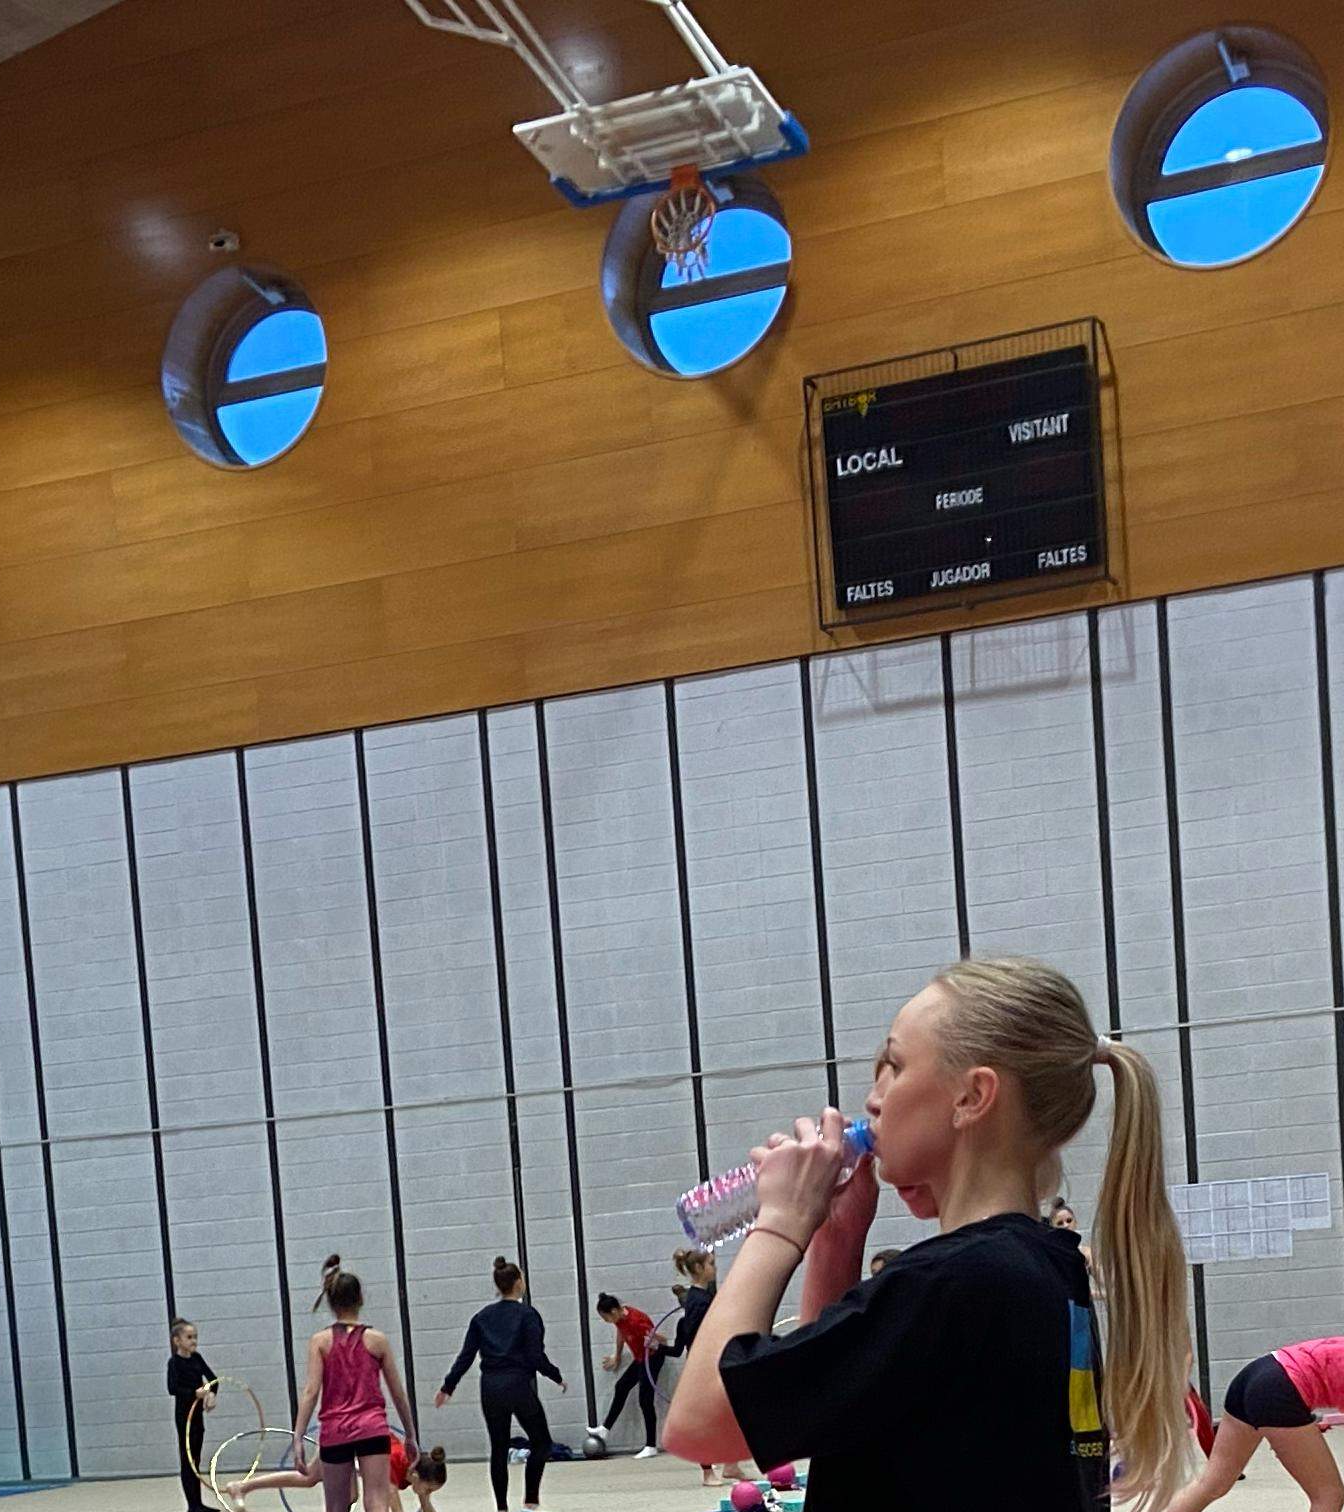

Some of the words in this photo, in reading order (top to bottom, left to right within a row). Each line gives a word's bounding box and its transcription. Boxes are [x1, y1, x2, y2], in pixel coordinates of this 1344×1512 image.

[1008, 413, 1069, 443] VISITANT
[836, 447, 904, 477] LOCAL
[1038, 545, 1087, 569] FALTES
[930, 562, 991, 588] JUGADOR
[847, 580, 894, 602] FALTES
